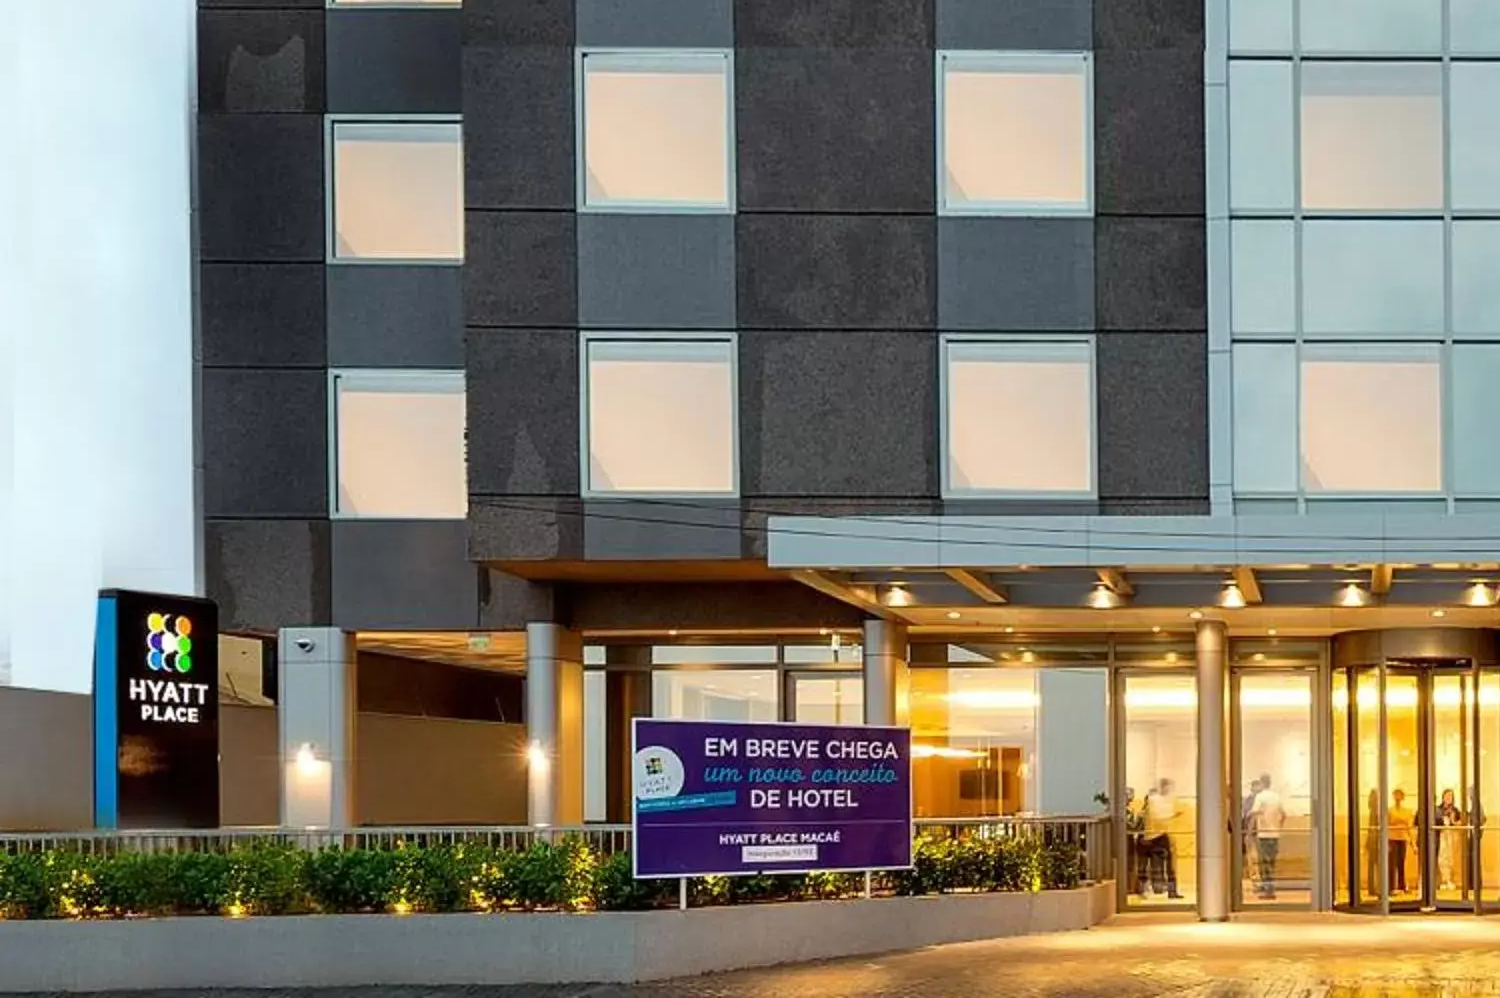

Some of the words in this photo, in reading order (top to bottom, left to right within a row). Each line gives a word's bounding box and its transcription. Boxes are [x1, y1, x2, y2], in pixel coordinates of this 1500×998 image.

[130, 678, 208, 705] HYATT
[141, 704, 199, 723] PLACE
[704, 737, 737, 757] EM
[746, 739, 819, 759] BREVE
[826, 740, 899, 759] CHEGA
[704, 766, 743, 782] um
[748, 768, 806, 783] novo
[811, 762, 898, 783] conceito
[751, 789, 780, 808] DE
[788, 789, 859, 808] HOTEL
[719, 833, 758, 845] HYATT
[760, 833, 798, 844] PLACE
[801, 830, 840, 843] MACAÉ
